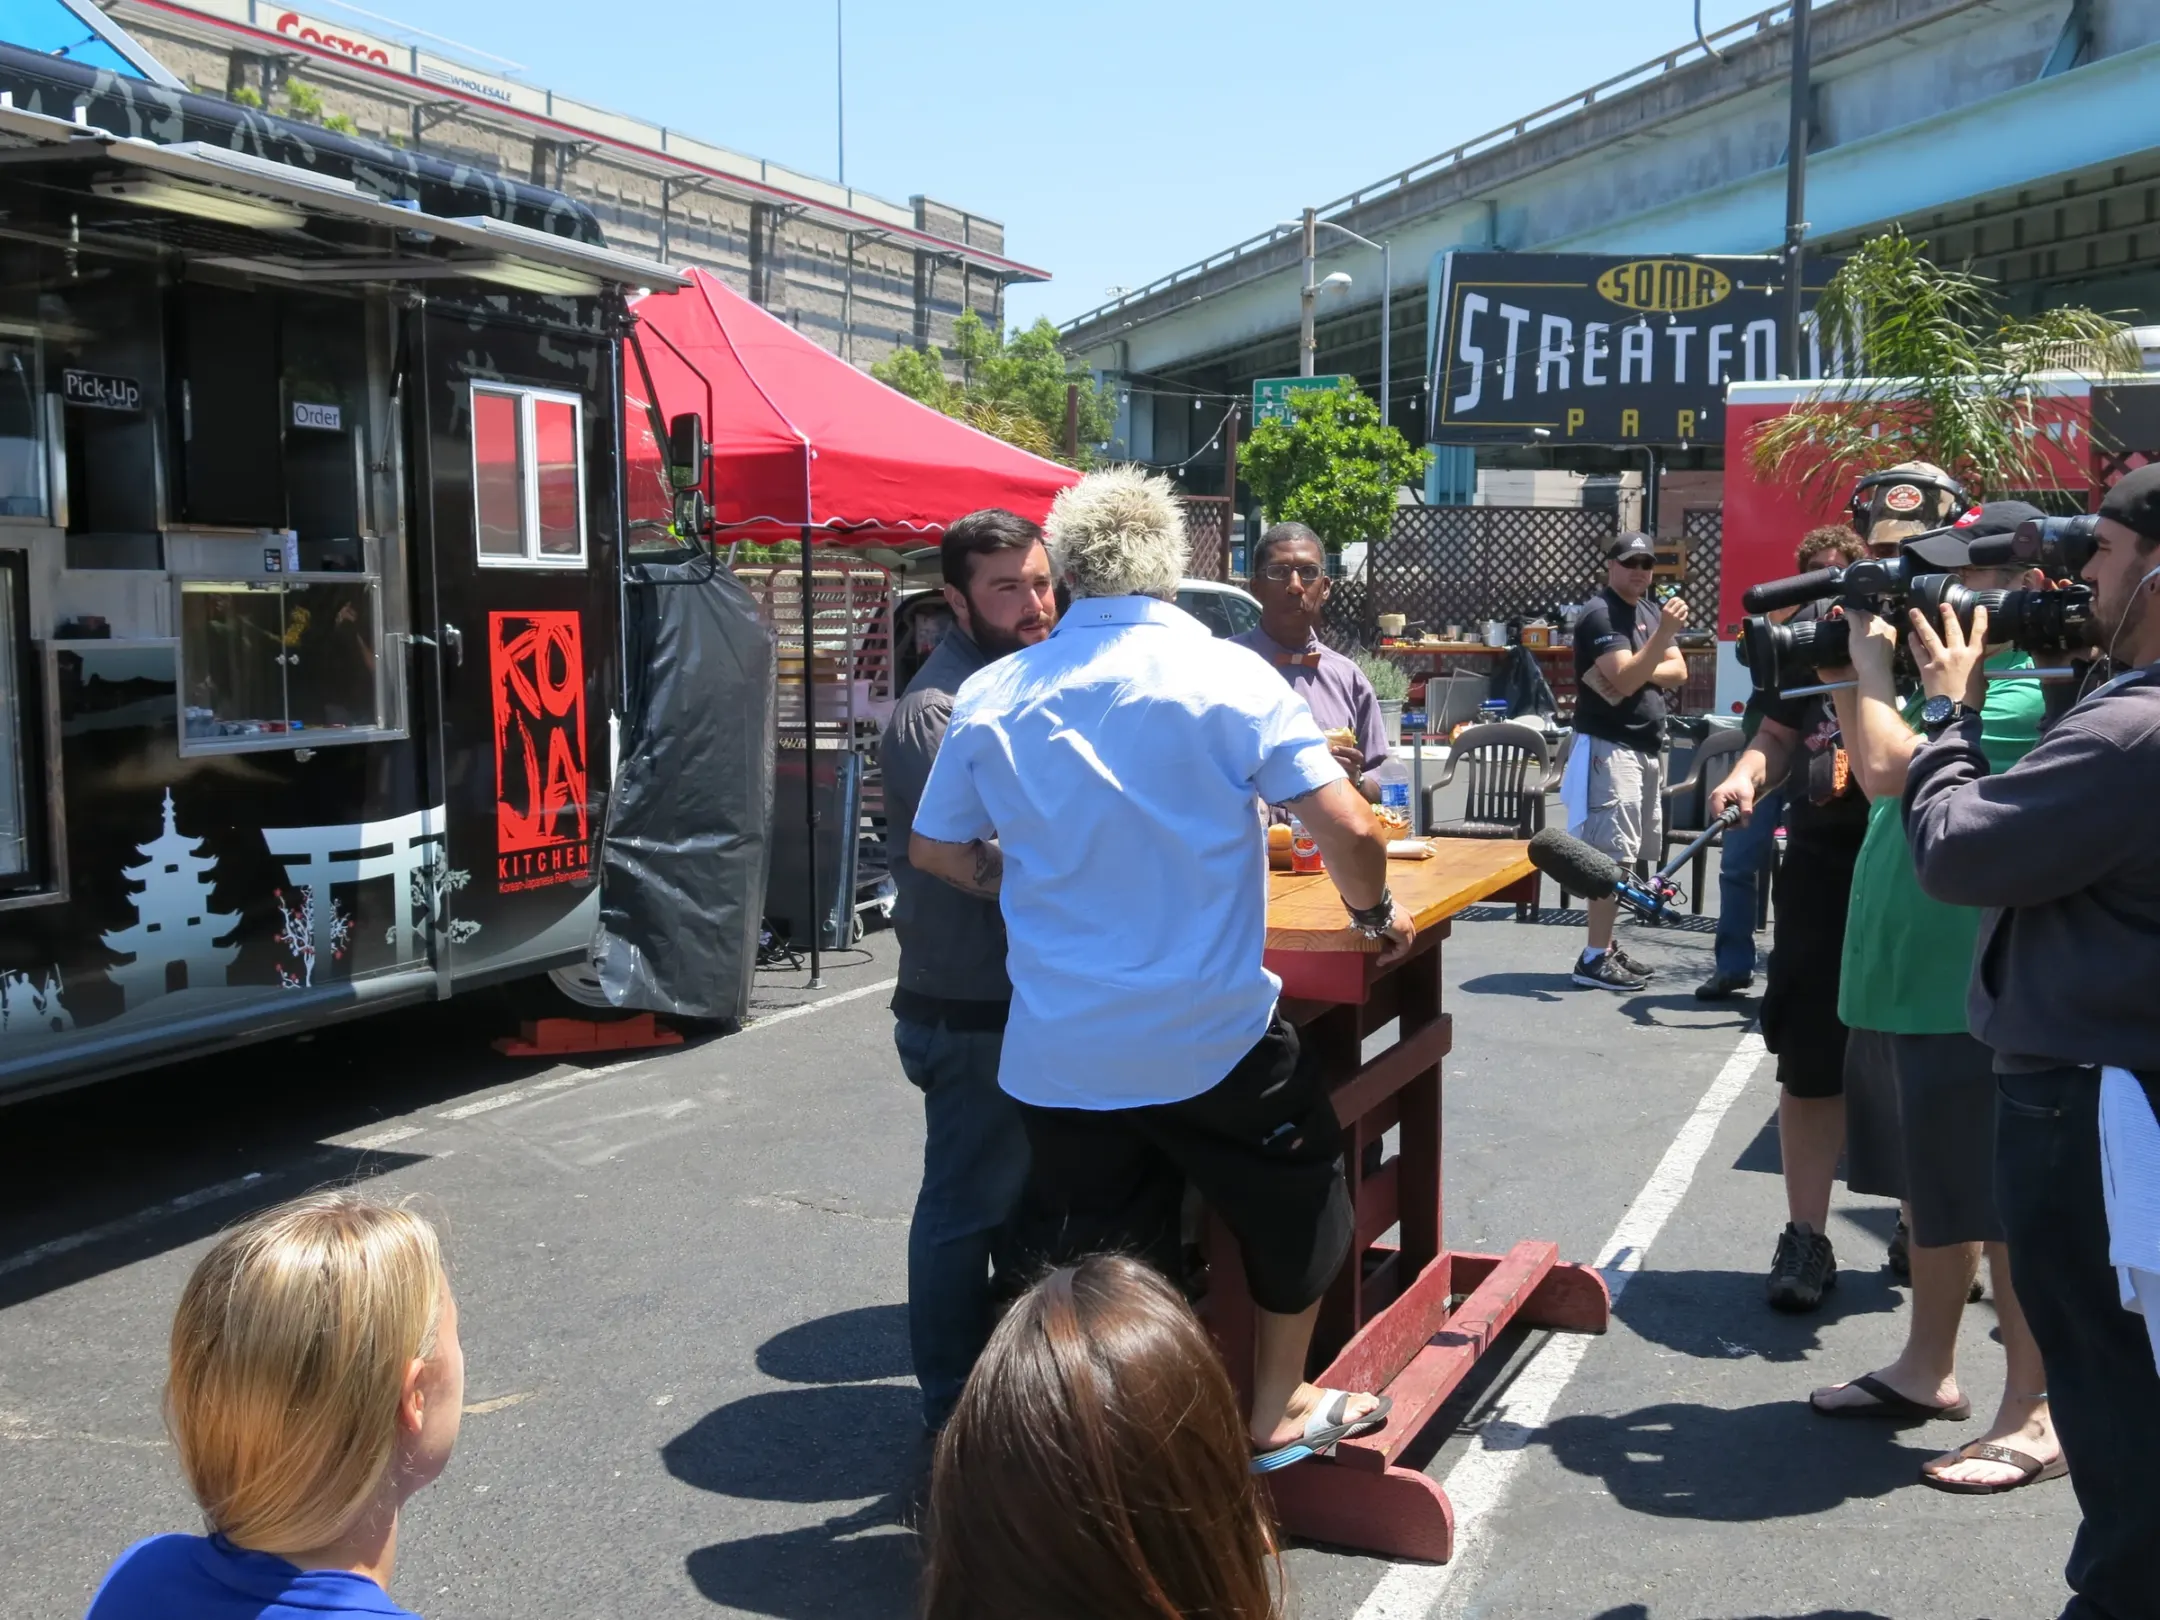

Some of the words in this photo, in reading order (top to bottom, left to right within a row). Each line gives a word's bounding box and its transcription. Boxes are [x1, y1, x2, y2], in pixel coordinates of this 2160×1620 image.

[450, 75, 512, 102] WHOLESALE
[1612, 263, 1717, 308] SOMA
[67, 373, 139, 408] Pick-Up
[295, 404, 339, 426] Order
[1567, 408, 1695, 438] PAR
[499, 845, 588, 879] KITCHEN
